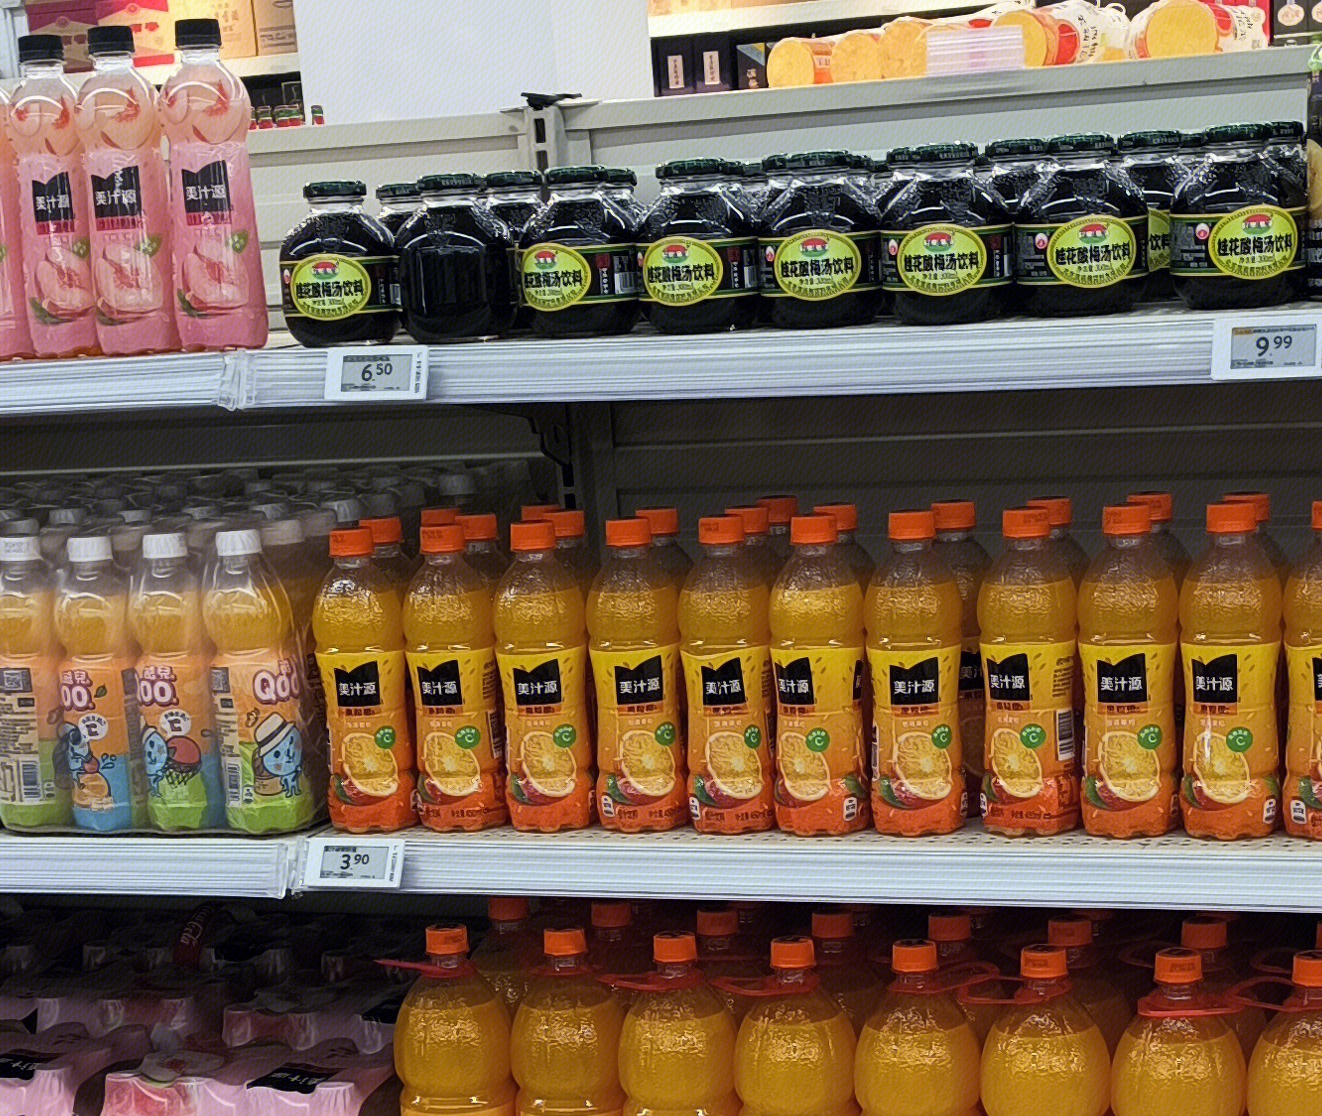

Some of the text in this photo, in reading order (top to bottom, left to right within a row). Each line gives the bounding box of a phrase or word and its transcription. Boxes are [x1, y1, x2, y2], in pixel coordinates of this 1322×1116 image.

[1256, 334, 1293, 358] 9.99
[361, 362, 393, 383] 6.50
[338, 680, 377, 697] 美汁源
[421, 680, 459, 696] 美汁源
[517, 679, 558, 696] 美汁源
[619, 677, 661, 695] 美汁源
[705, 679, 741, 695] 美汁源
[893, 677, 935, 695] 美汁源
[990, 673, 1025, 690] 美汁源
[1100, 675, 1143, 692] 美汁源
[1195, 675, 1234, 692] 美汁源
[339, 854, 370, 872] 3.90
